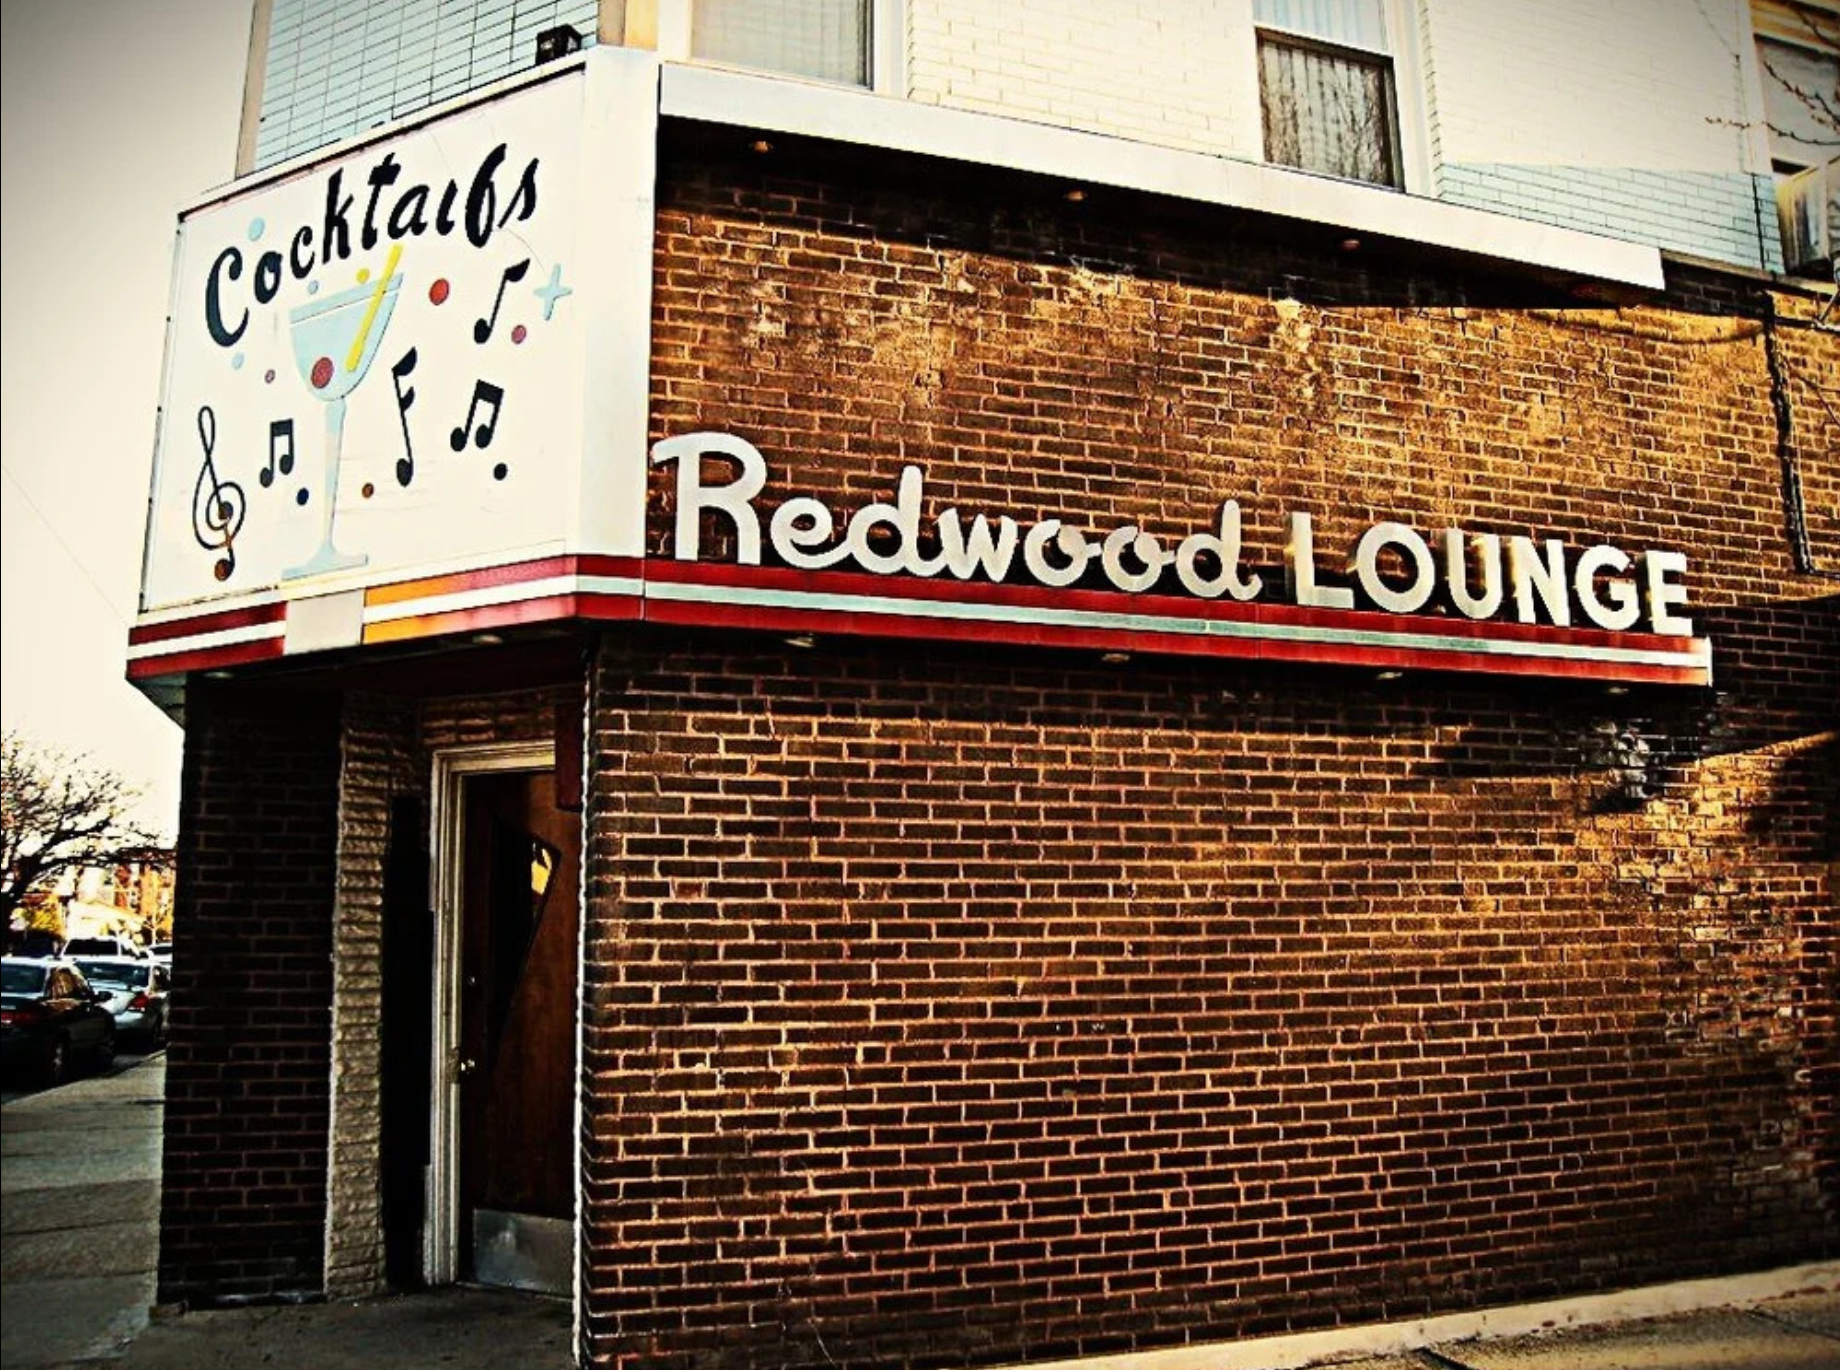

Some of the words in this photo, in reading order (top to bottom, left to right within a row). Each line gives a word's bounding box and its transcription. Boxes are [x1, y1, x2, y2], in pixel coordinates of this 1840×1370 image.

[205, 143, 540, 348] Cocktails
[652, 431, 1263, 601] Redwood
[1290, 511, 1693, 637] LOUNGE
